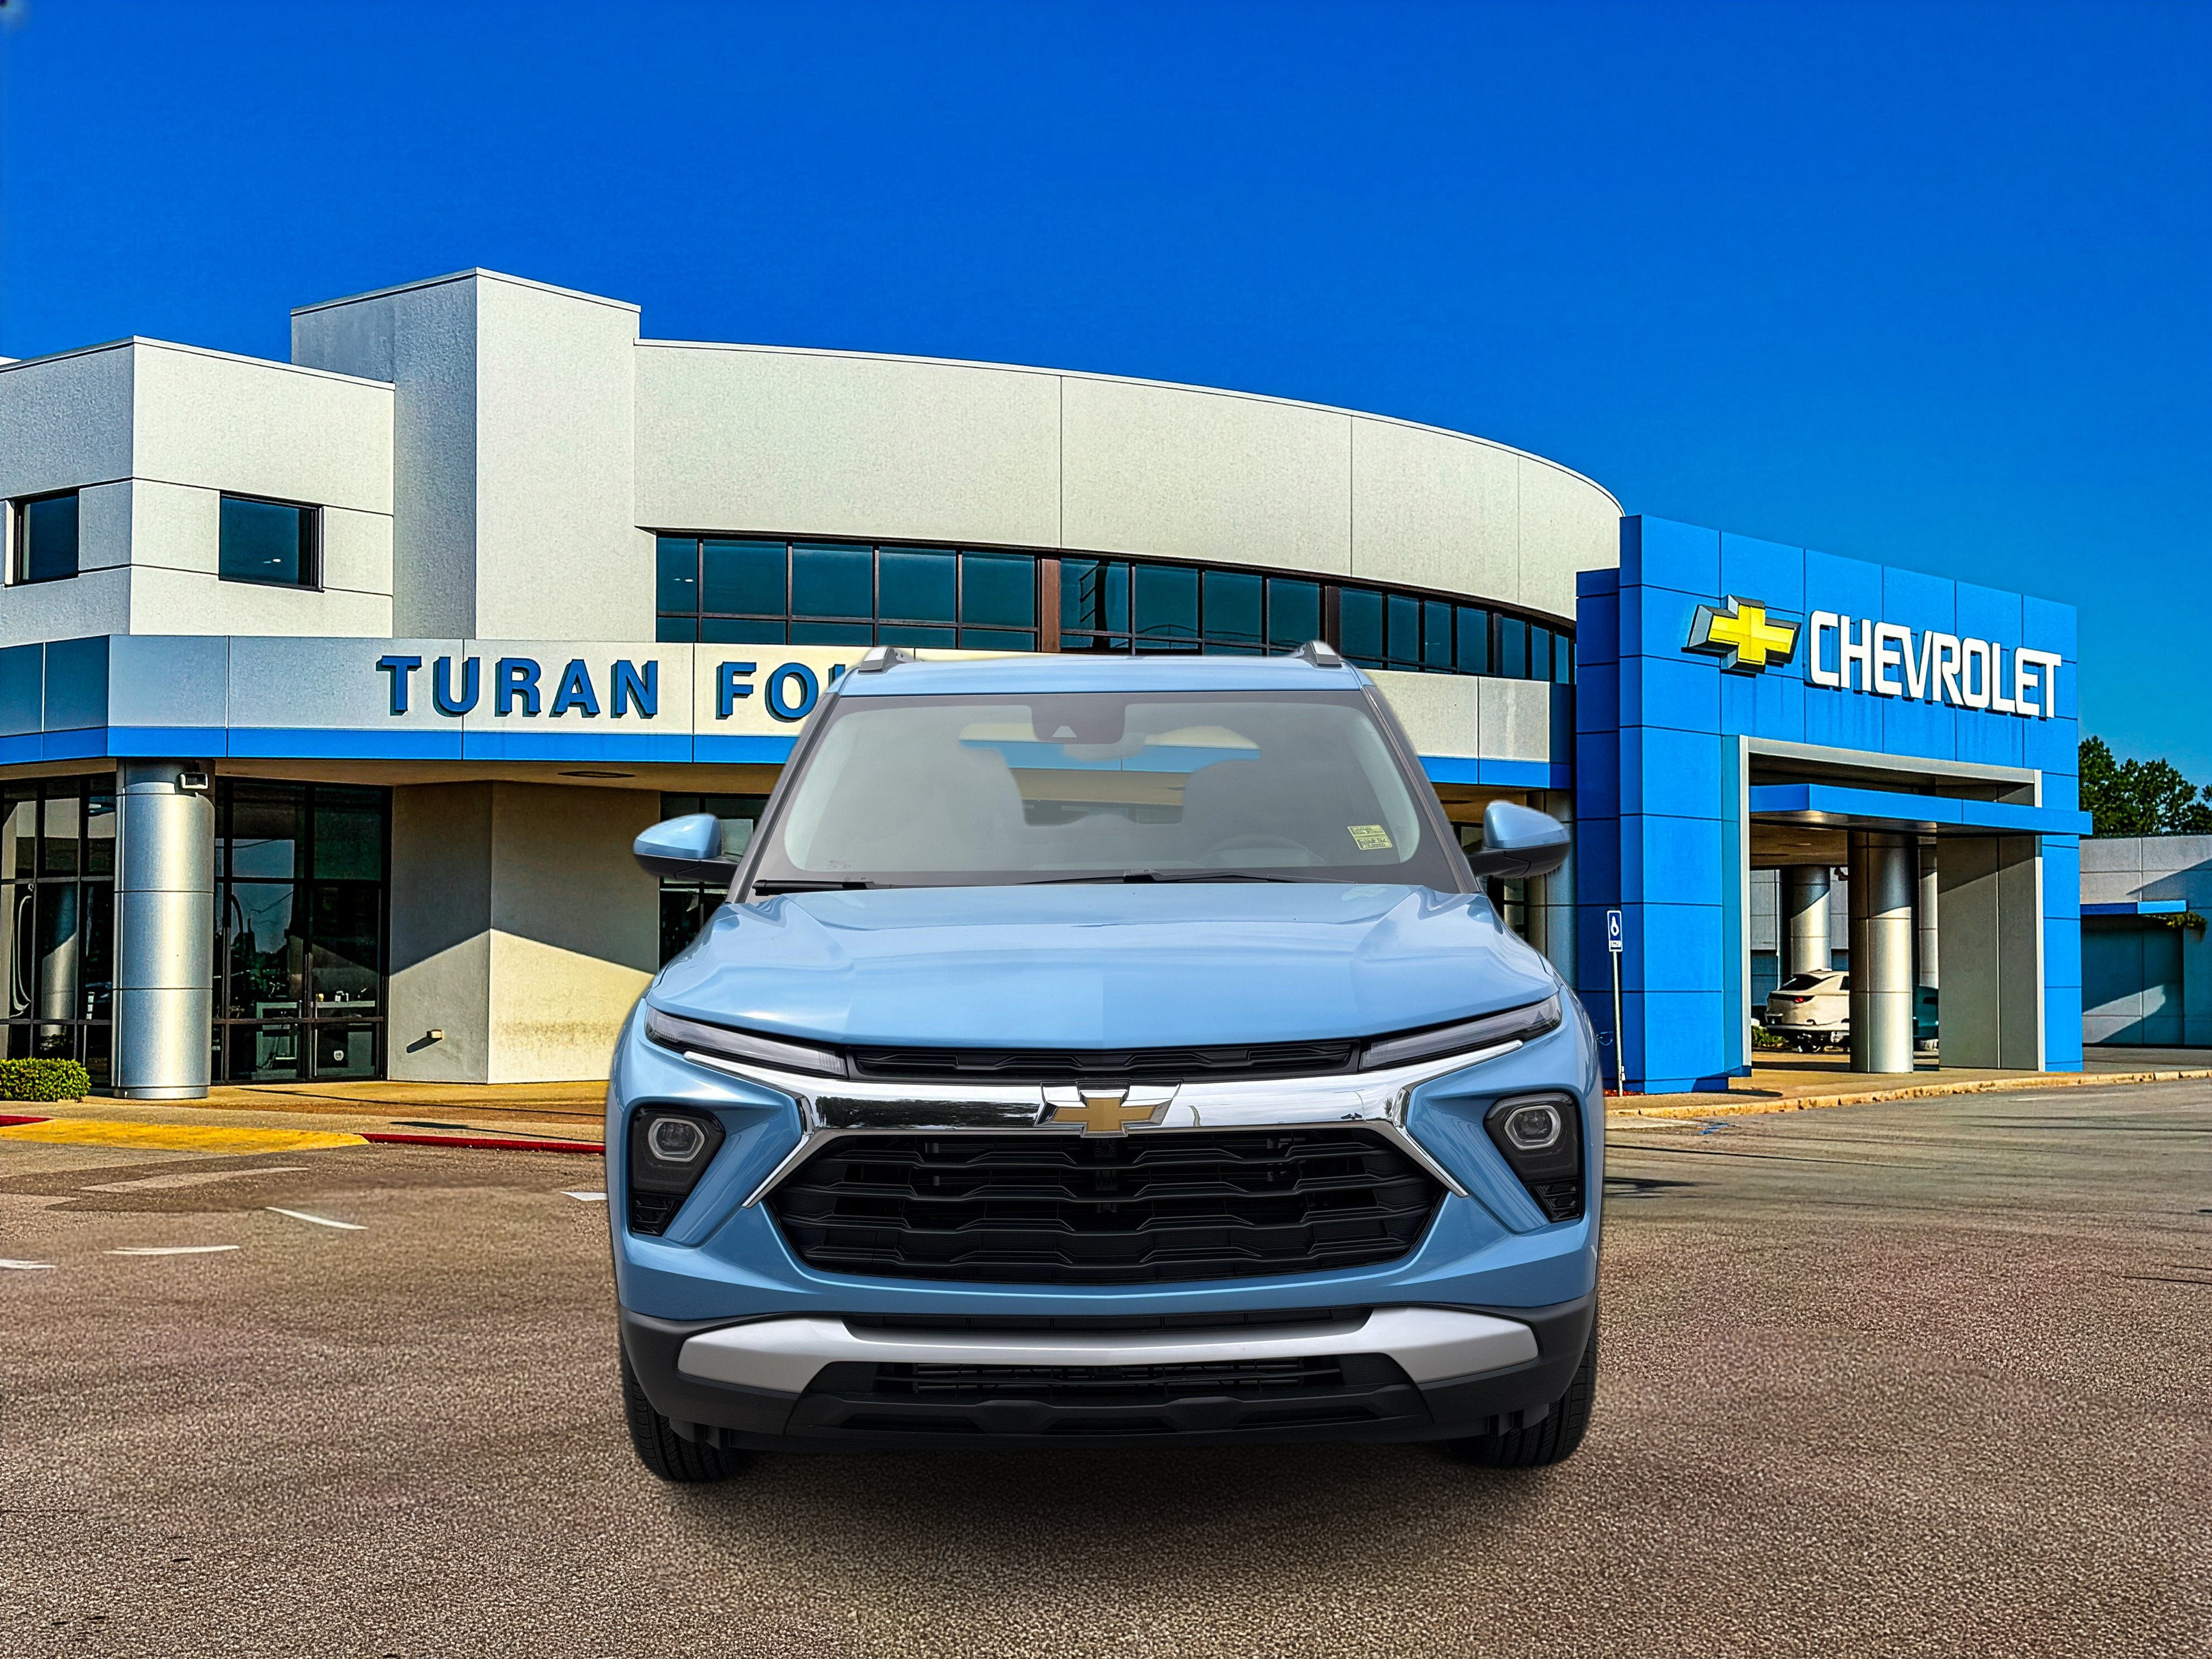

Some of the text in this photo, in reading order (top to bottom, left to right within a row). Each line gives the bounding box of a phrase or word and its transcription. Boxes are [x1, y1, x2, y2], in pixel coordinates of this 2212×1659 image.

[377, 655, 846, 723] TURAN FO
[1810, 610, 2062, 718] CHEVROLET
